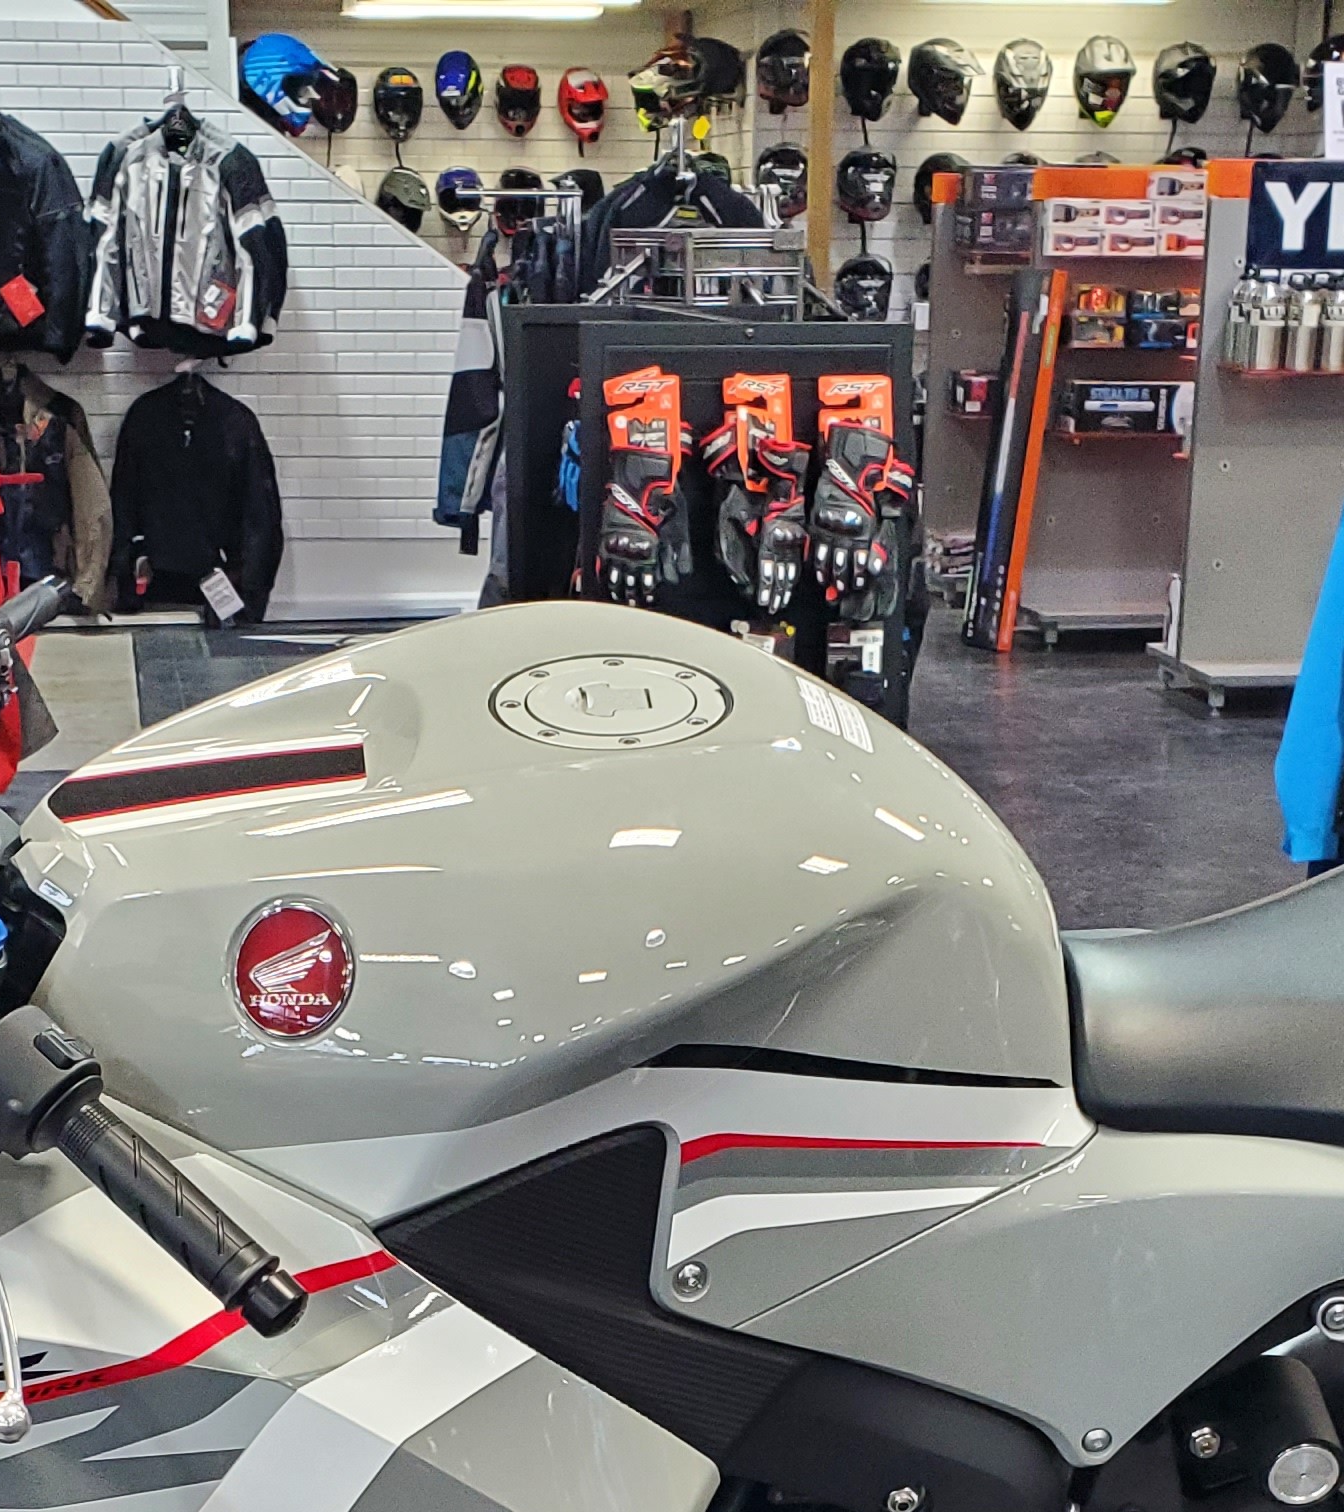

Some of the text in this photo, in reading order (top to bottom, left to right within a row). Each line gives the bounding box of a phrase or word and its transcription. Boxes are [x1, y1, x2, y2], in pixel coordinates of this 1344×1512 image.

[615, 380, 675, 393] RST
[739, 379, 785, 394] RST
[827, 380, 886, 393] RST
[249, 993, 332, 1007] HONDA
